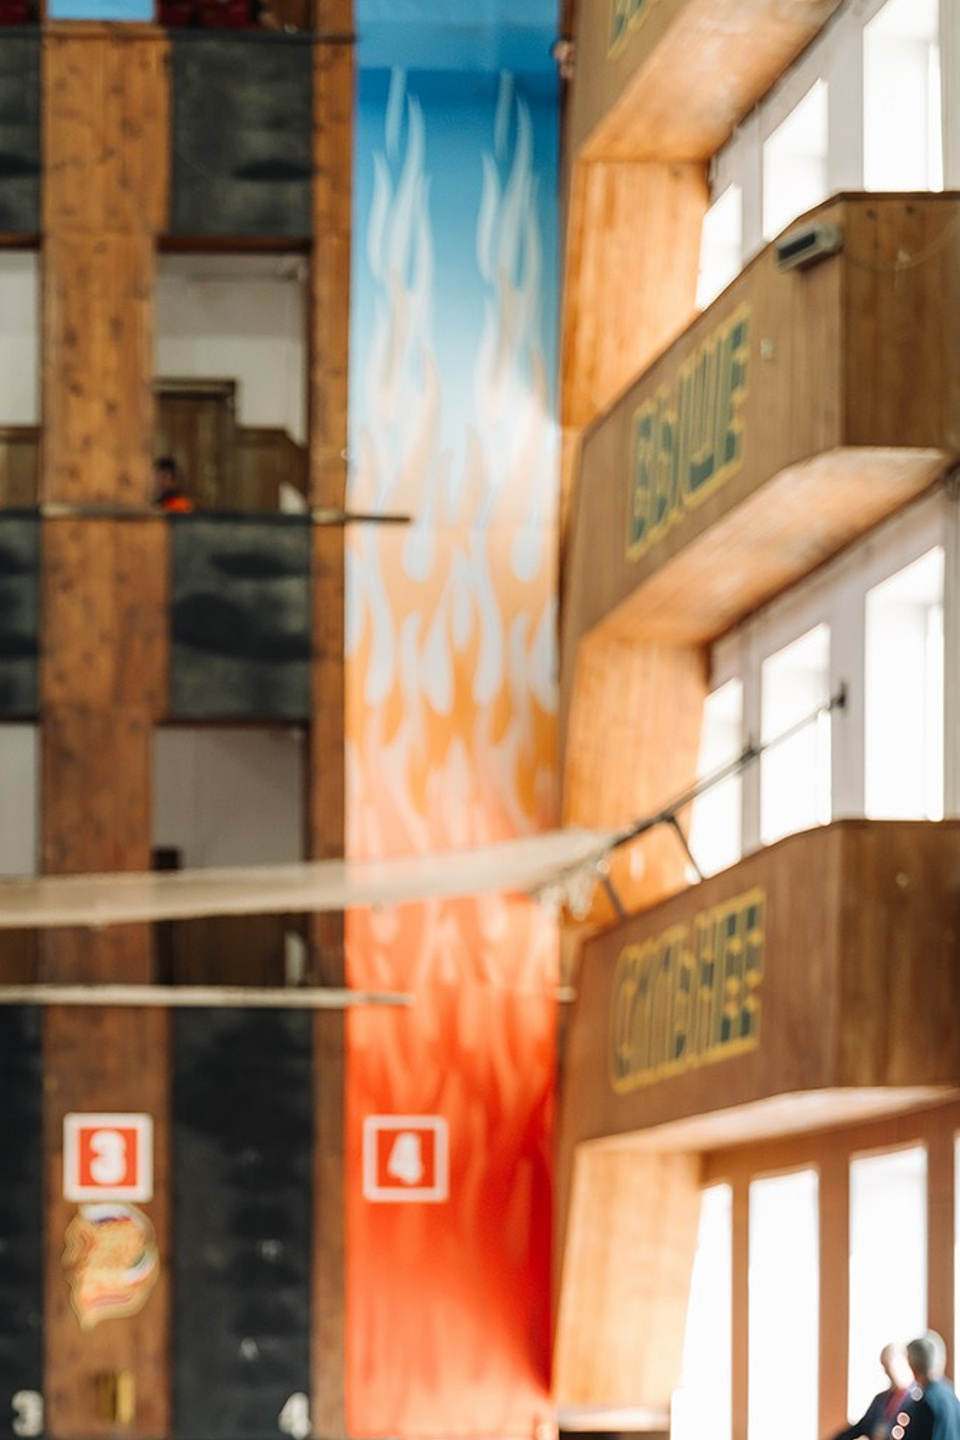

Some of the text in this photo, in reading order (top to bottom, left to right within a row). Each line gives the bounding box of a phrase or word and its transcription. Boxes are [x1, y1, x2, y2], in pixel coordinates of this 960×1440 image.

[88, 1129, 127, 1185] 3
[388, 1131, 424, 1185] 4
[11, 1390, 44, 1437] 3
[279, 1392, 312, 1440] 4
